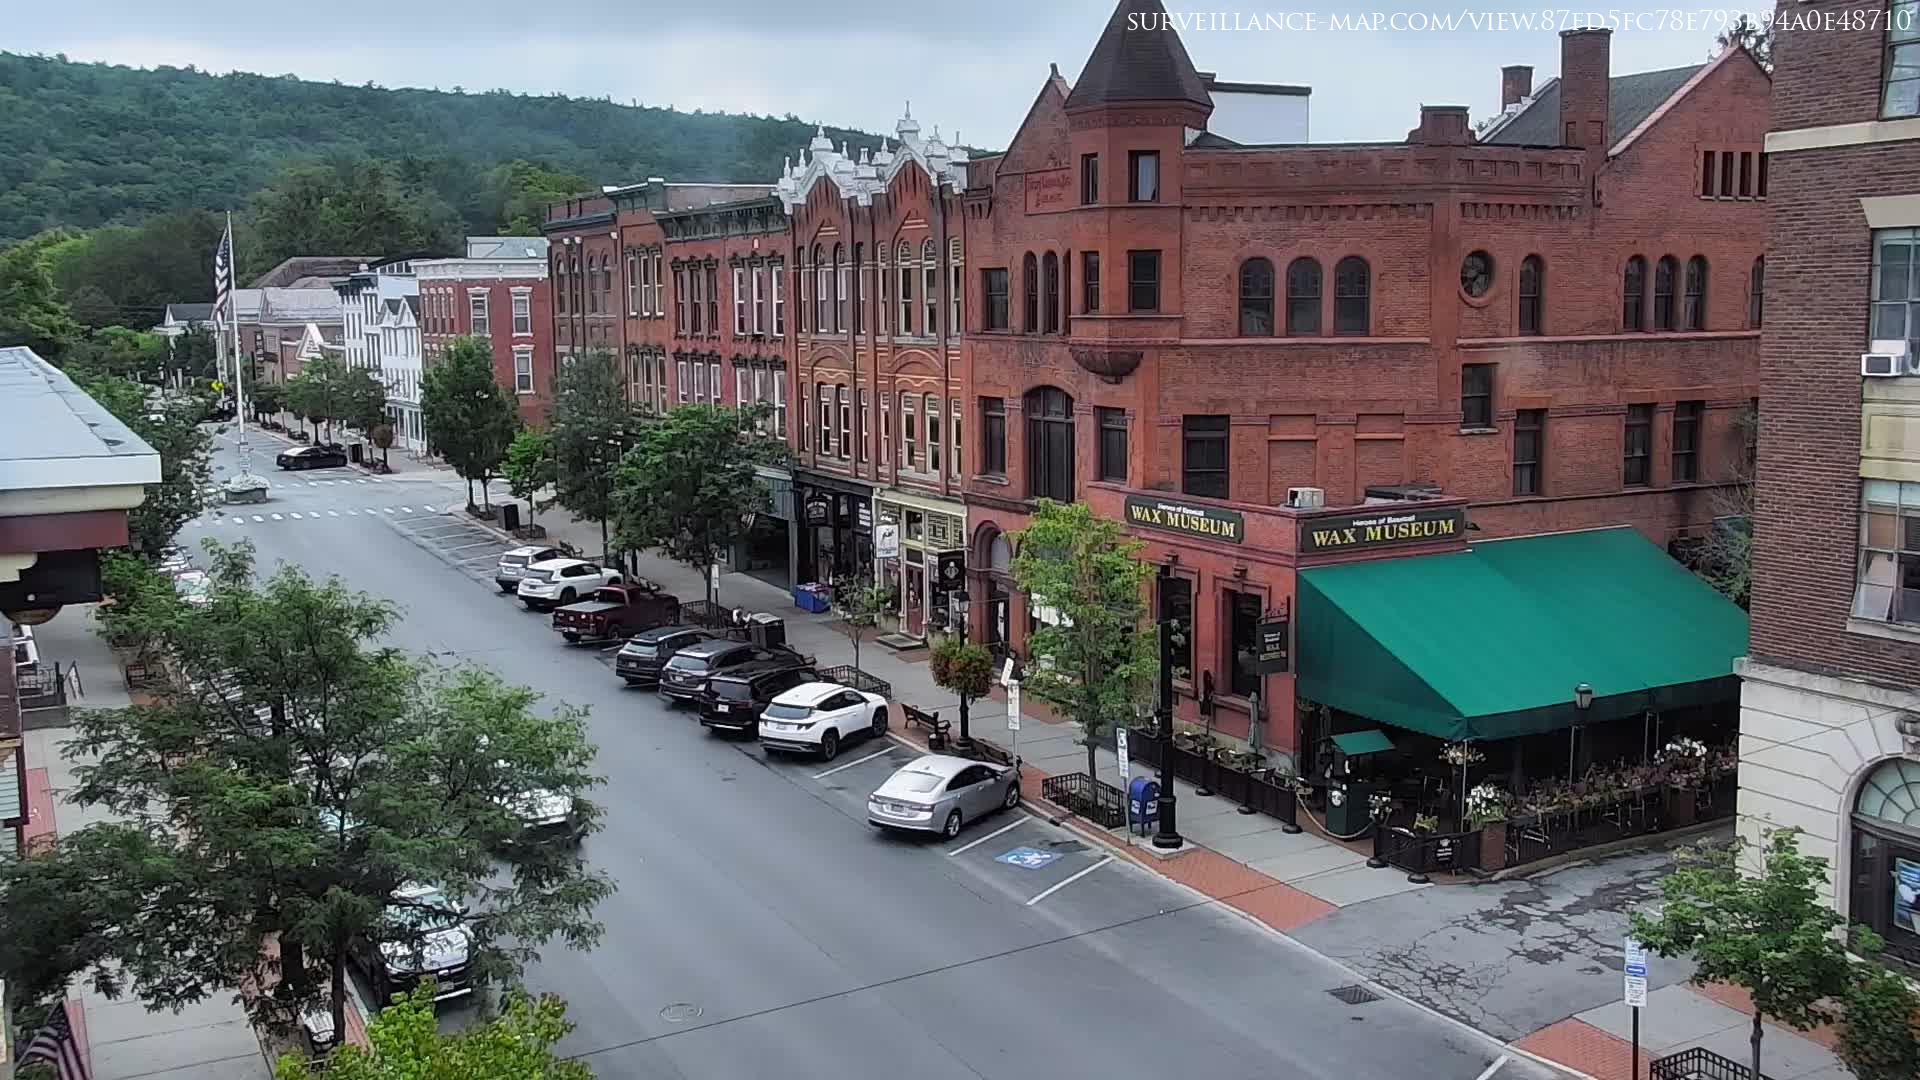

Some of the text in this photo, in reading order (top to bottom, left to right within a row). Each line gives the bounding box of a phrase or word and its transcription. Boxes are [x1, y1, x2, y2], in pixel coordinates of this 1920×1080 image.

[1131, 505, 1235, 537] WAX MUSEUM
[1312, 519, 1455, 547] WAX MUSEUM
